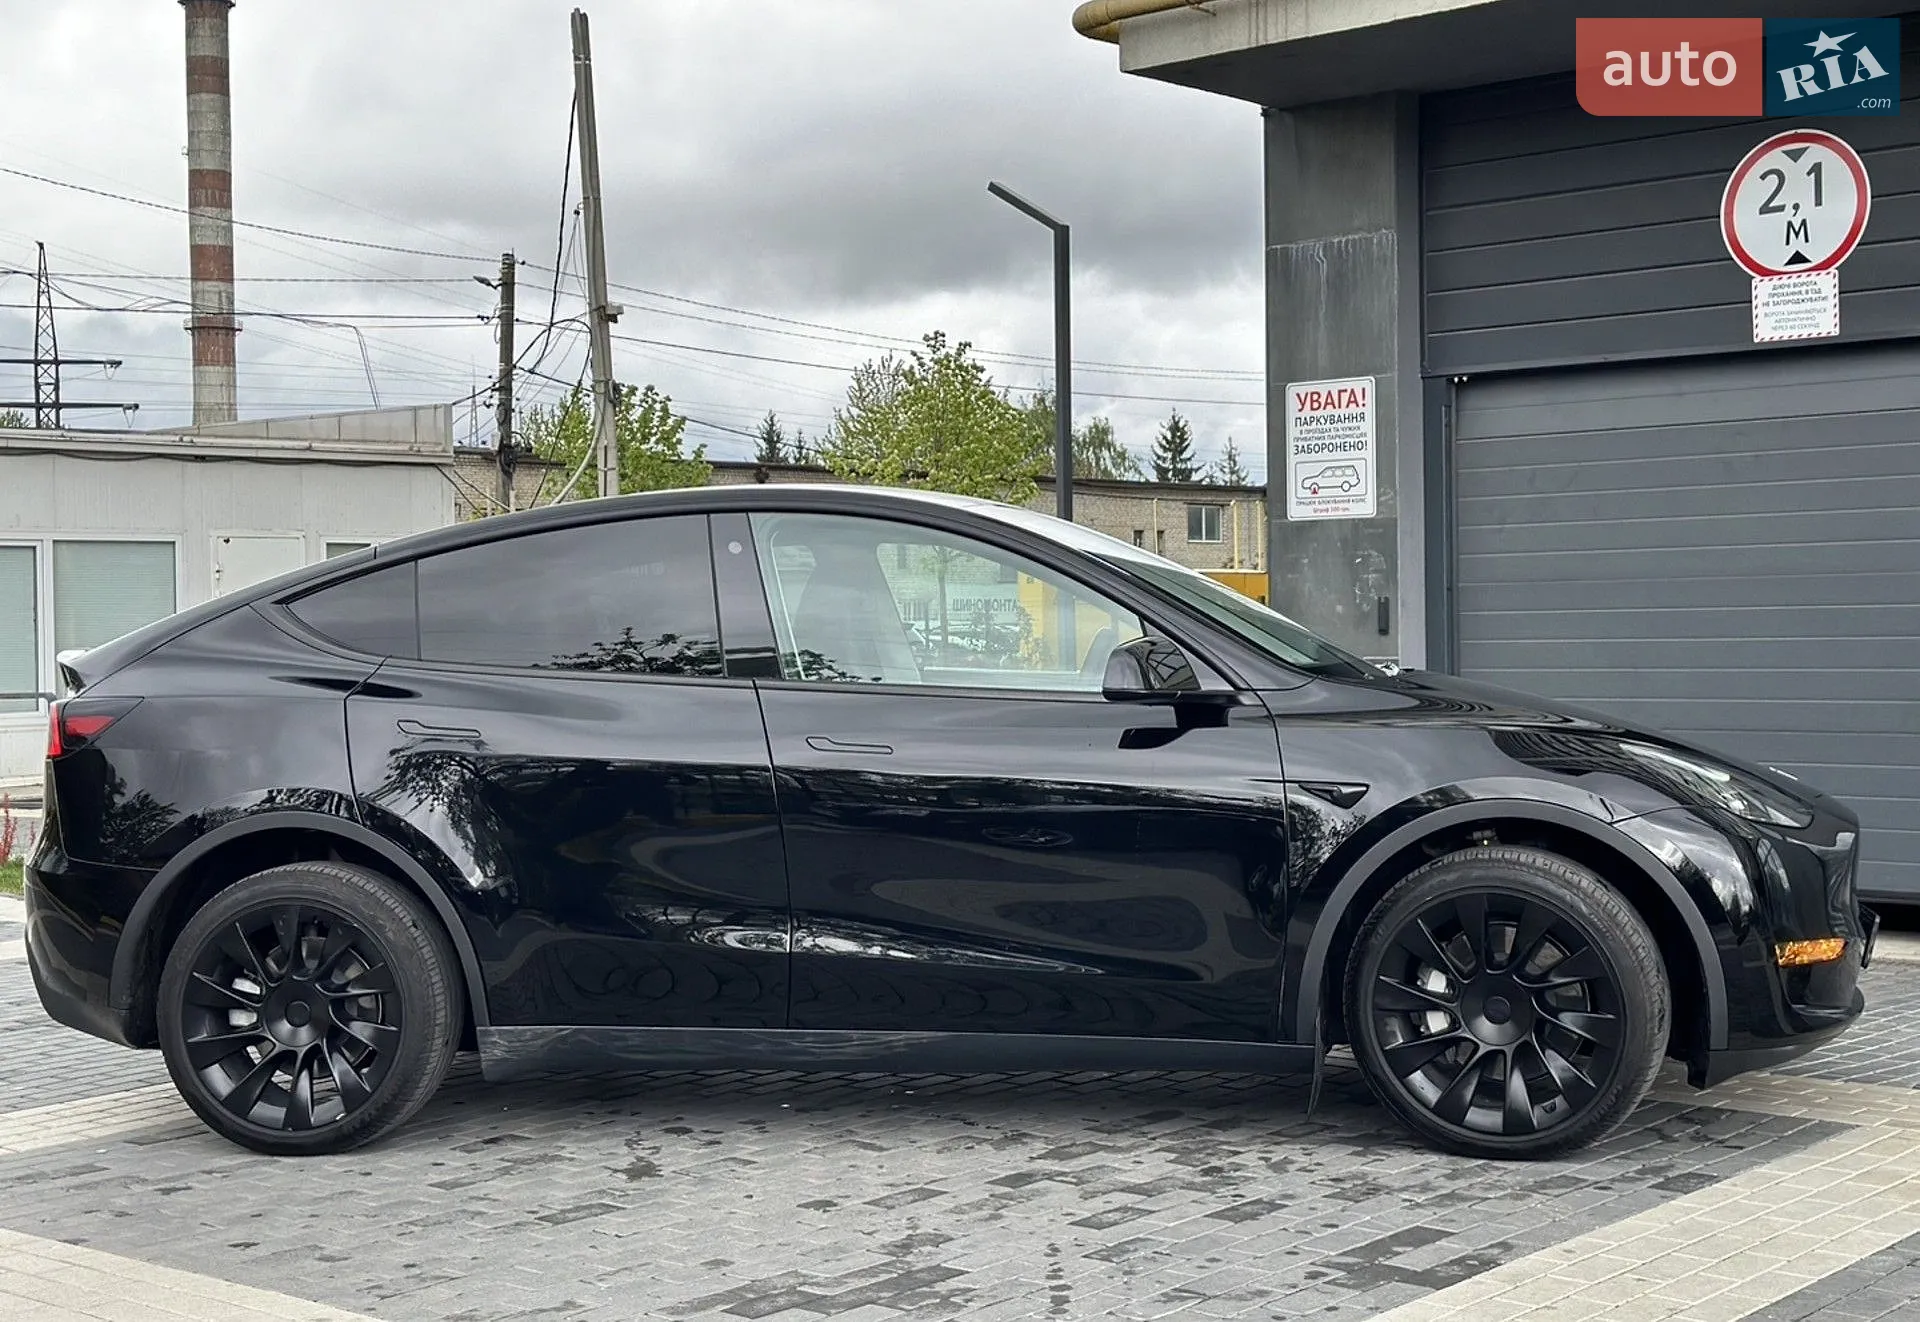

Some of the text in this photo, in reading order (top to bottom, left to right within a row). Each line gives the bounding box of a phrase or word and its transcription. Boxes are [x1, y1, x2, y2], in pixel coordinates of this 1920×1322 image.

[1758, 161, 1822, 217] 2,1
[1296, 387, 1366, 412] УВАГА!
[1294, 412, 1365, 428] ПАРКУВАННЯ
[1293, 440, 1368, 455] ЗАБОРОНЕНО!
